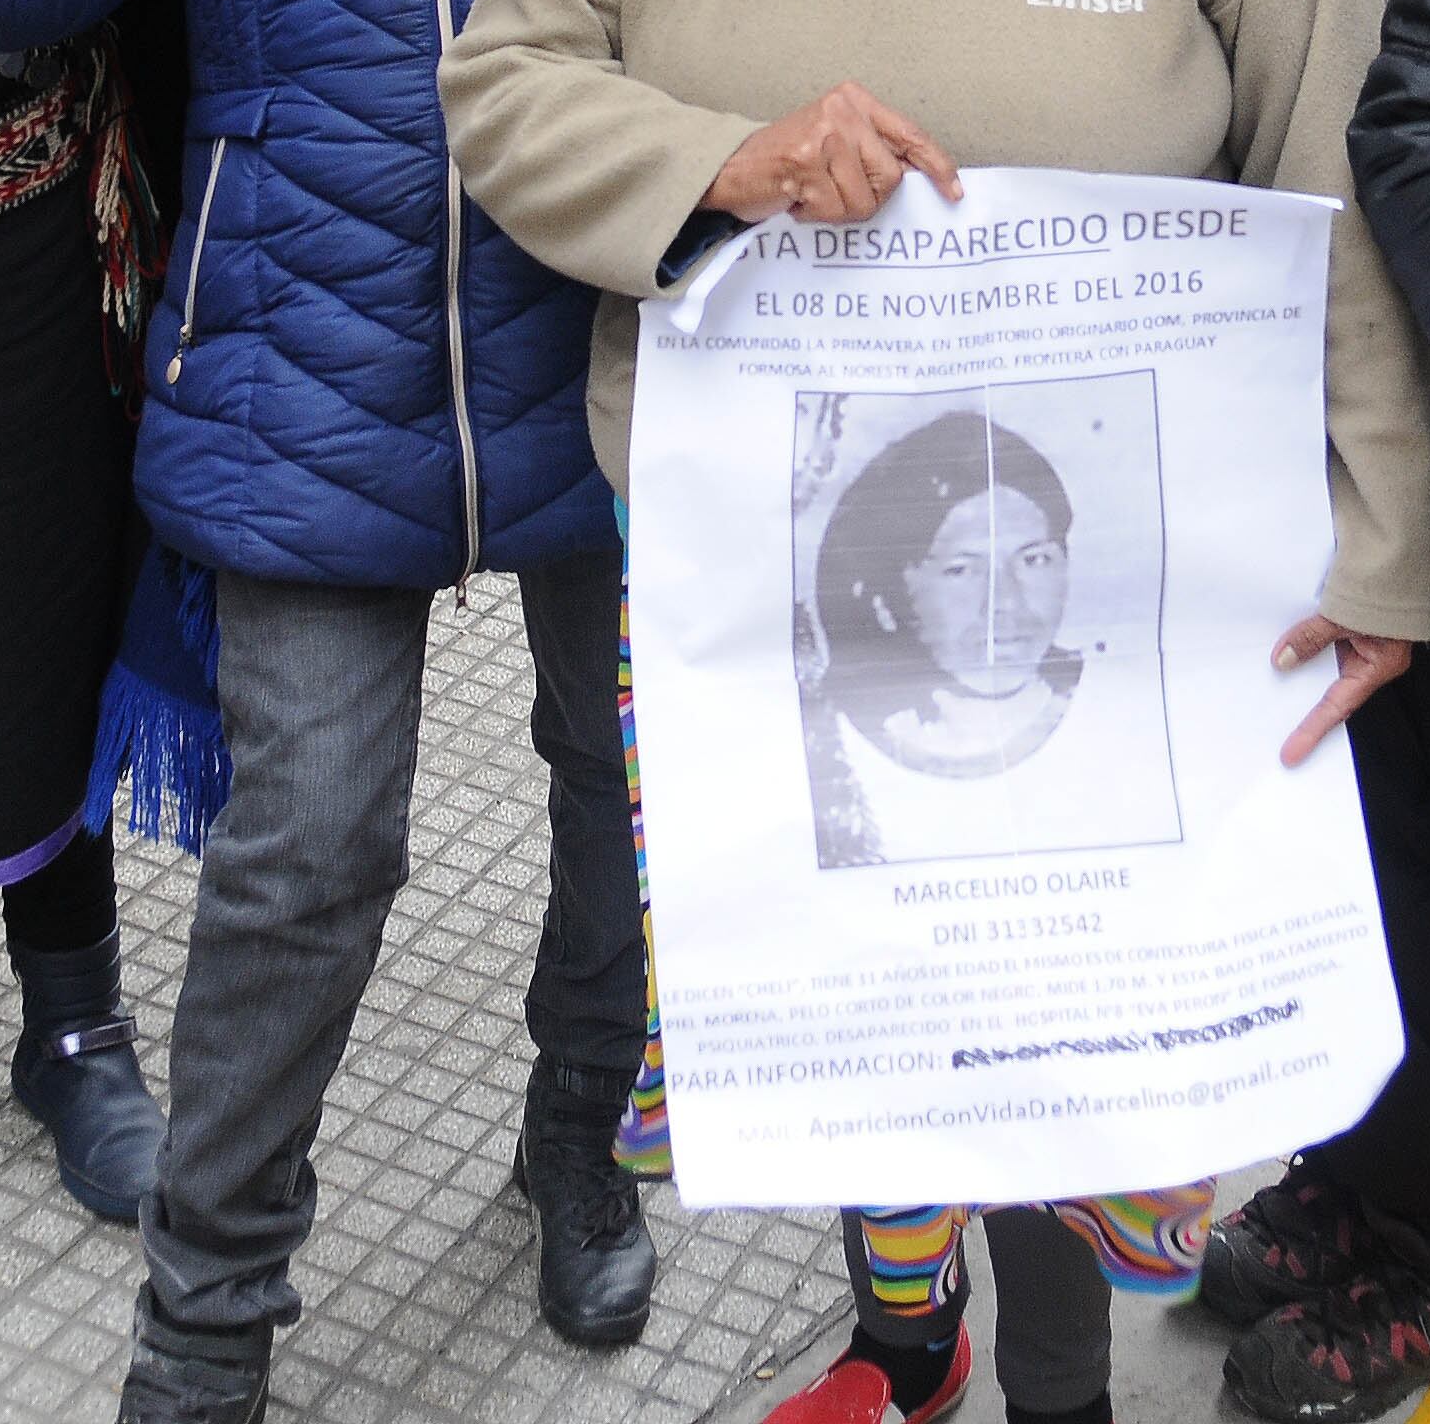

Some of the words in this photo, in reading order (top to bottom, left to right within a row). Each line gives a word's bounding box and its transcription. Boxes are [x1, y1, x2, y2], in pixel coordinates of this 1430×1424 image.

[814, 213, 1108, 260] DESAPARECIDO
[1122, 208, 1250, 241] DESDE
[755, 292, 783, 317] EL
[792, 292, 823, 317] 08
[834, 292, 870, 317] DE
[883, 281, 1059, 317] NOVIEMBRE
[1074, 276, 1124, 303] DEL
[1134, 270, 1204, 297] 2016
[681, 336, 700, 350] LA
[705, 336, 802, 352] COMUNIDAD
[808, 337, 825, 351] LA
[831, 337, 924, 353] PRIMAVERA
[932, 337, 951, 352] EN
[959, 328, 1044, 350] TERRITORIO
[1049, 318, 1139, 340] ORIGINARIO
[1192, 308, 1277, 327] PROVINCIA
[1283, 305, 1303, 321] DE
[738, 362, 812, 377] FORMOSA
[818, 364, 836, 378] AL
[843, 363, 909, 379] NORESTE
[1014, 350, 1094, 368] FRONTERA
[1099, 343, 1130, 359] CON
[1134, 336, 1218, 356] PARAGUAY
[892, 874, 1039, 906] MARCELINO
[1046, 867, 1132, 895] OLAIRE
[933, 921, 977, 947] DNI
[1127, 939, 1228, 964] CONTEXTURA
[789, 1004, 830, 1021] PELO
[835, 996, 891, 1017] CORTO
[921, 988, 975, 1009] COLOR
[1215, 957, 1254, 978] BAJO
[1259, 924, 1370, 967] TRATAMIENTO
[1238, 983, 1258, 1000] DE
[671, 1066, 740, 1092] PARA
[747, 1051, 944, 1087] INFORMACION:
